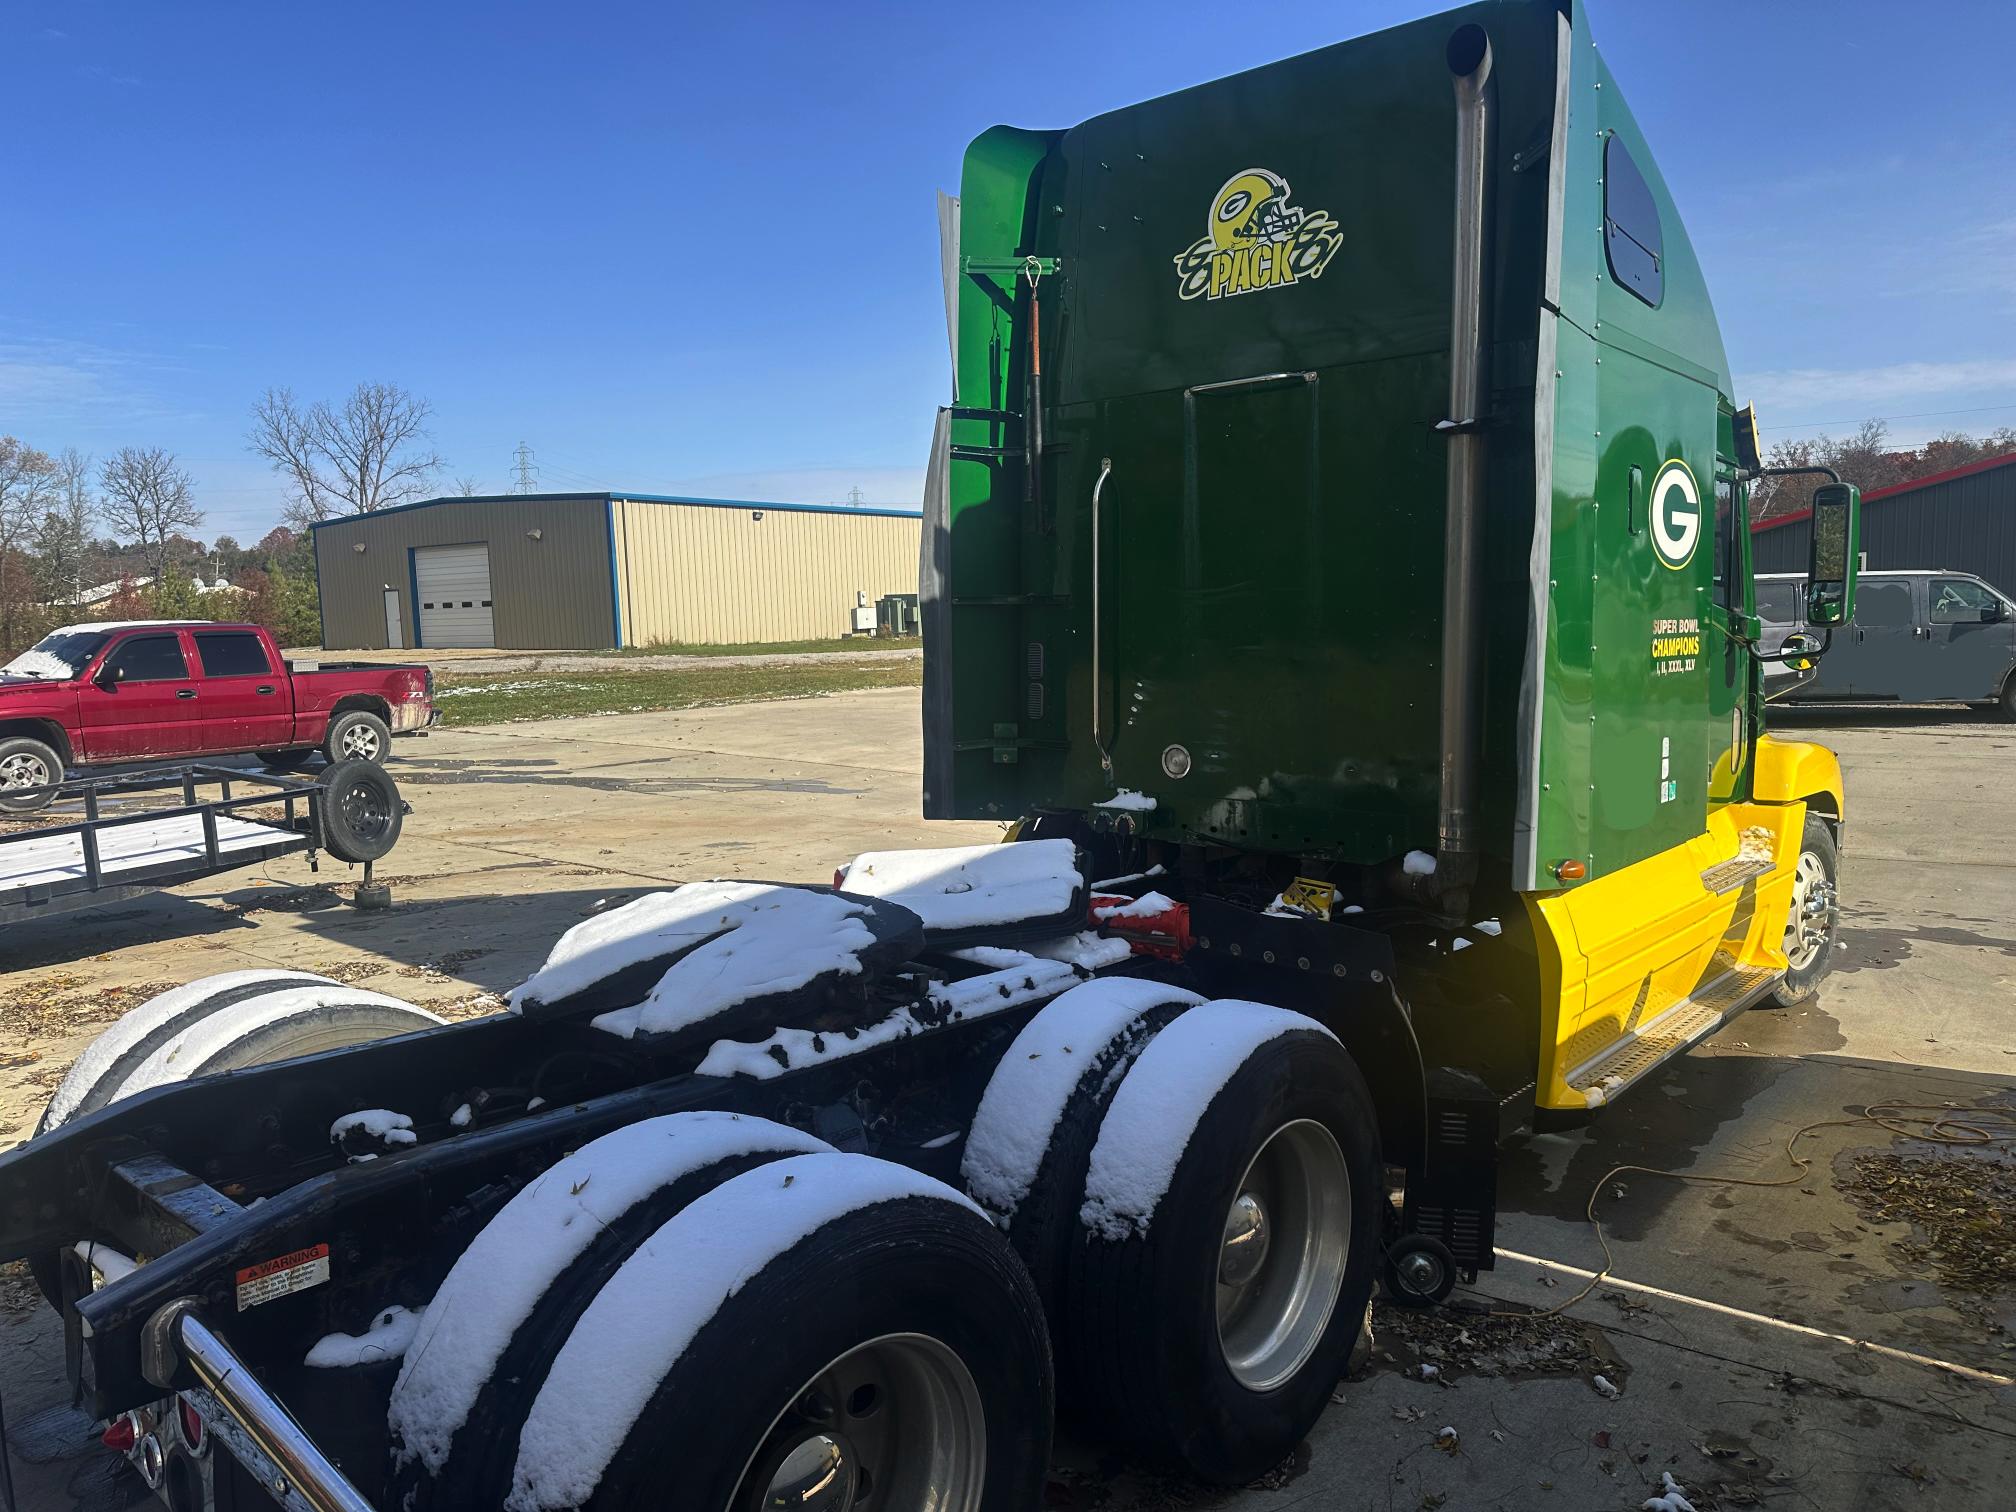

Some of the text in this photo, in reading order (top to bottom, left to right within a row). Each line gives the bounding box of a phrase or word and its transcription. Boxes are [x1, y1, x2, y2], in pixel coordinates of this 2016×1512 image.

[1208, 240, 1298, 299] PACK
[1653, 469, 1698, 560] G
[1652, 619, 1699, 634] SUPER BOWL
[1652, 636, 1699, 657] CHAMPIONS
[260, 1248, 320, 1274] WARNING
